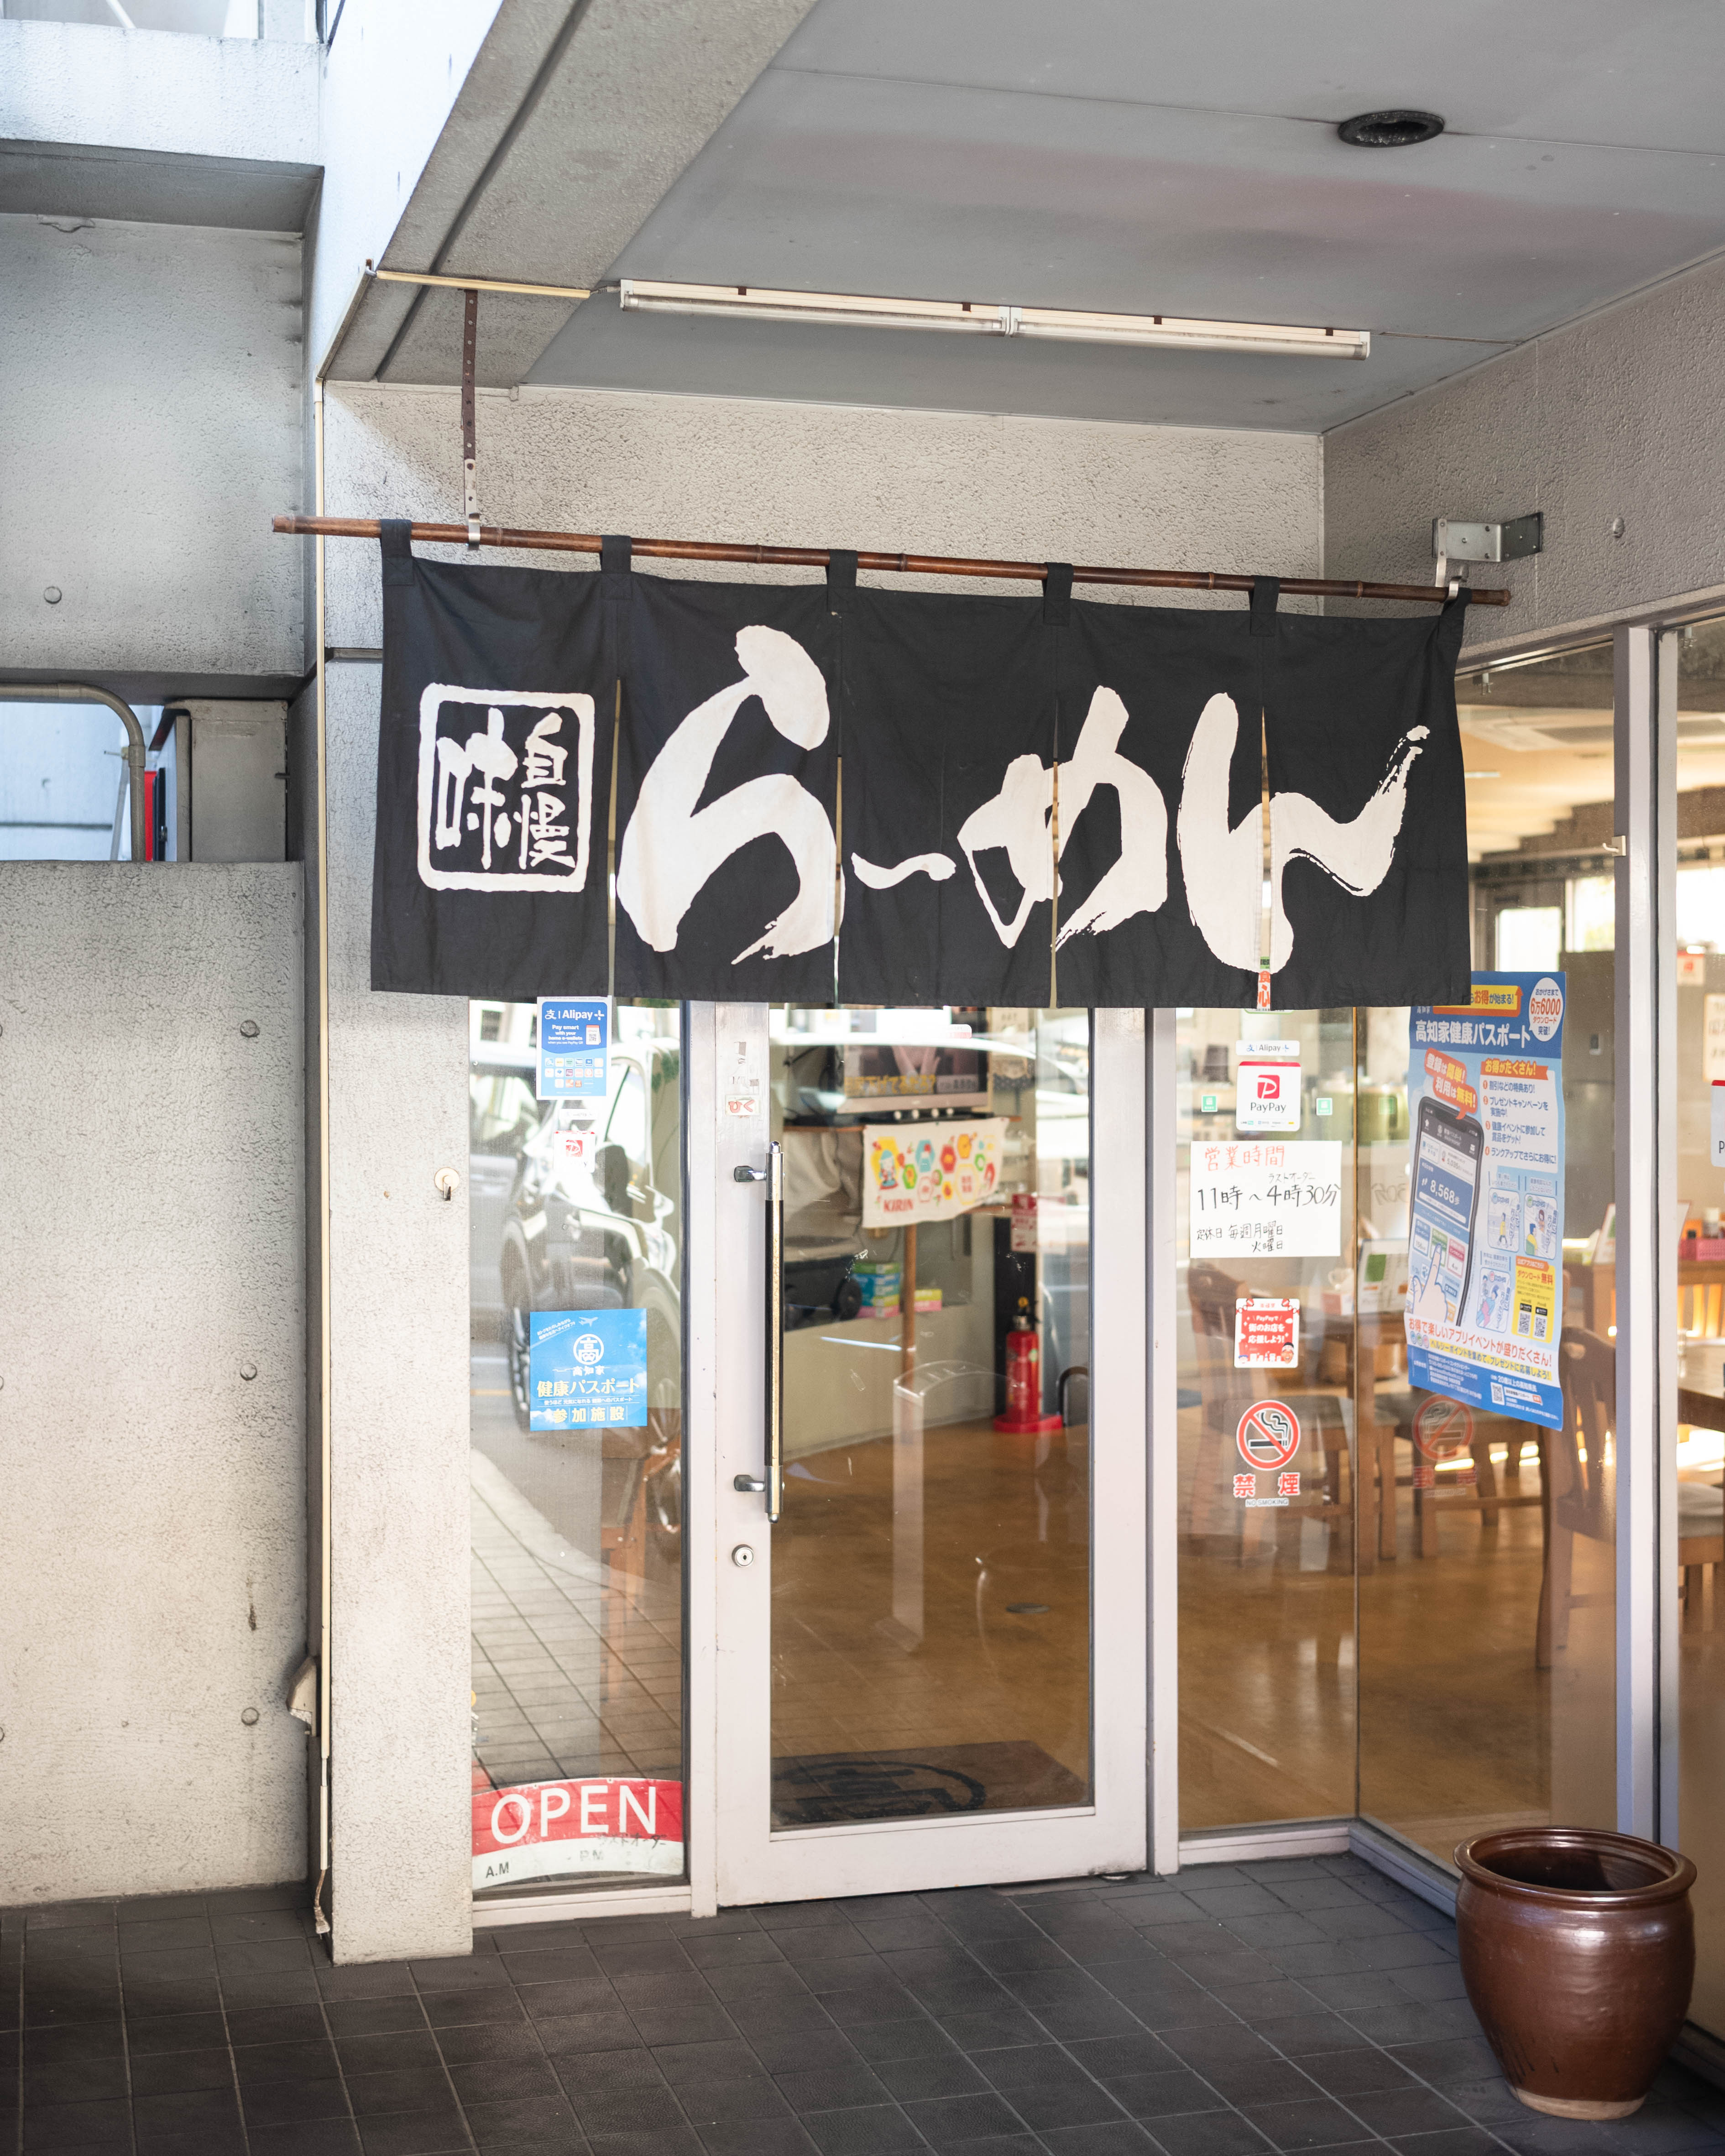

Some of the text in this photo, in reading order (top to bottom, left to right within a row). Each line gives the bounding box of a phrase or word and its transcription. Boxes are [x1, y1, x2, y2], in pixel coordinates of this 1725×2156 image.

[1530, 997, 1561, 1015] 6万6000
[1533, 1016, 1557, 1024] ダウンロード
[1416, 1019, 1531, 1049] 高知家健康パスポート
[1485, 1060, 1537, 1076] お得がたくさん!
[1435, 1076, 1476, 1108] 利用は無料!
[1250, 1102, 1286, 1113] PayPay
[1205, 1145, 1285, 1171] 営業時間
[1268, 1172, 1316, 1184] ラストオーダー
[1197, 1221, 1283, 1240] 定休日 毎週月曜日
[1252, 1238, 1283, 1252] 火曜日
[1248, 1323, 1286, 1332] 街のお店を
[1248, 1335, 1285, 1344] 応援しよう!
[1409, 1317, 1552, 1367] お得で楽しいアプリイベントが盛りだくさん!
[573, 1365, 605, 1376] 高知家
[537, 1378, 640, 1397] 健康パスポート
[554, 1406, 625, 1424] 参加施設
[491, 1785, 656, 1844] OPEN
